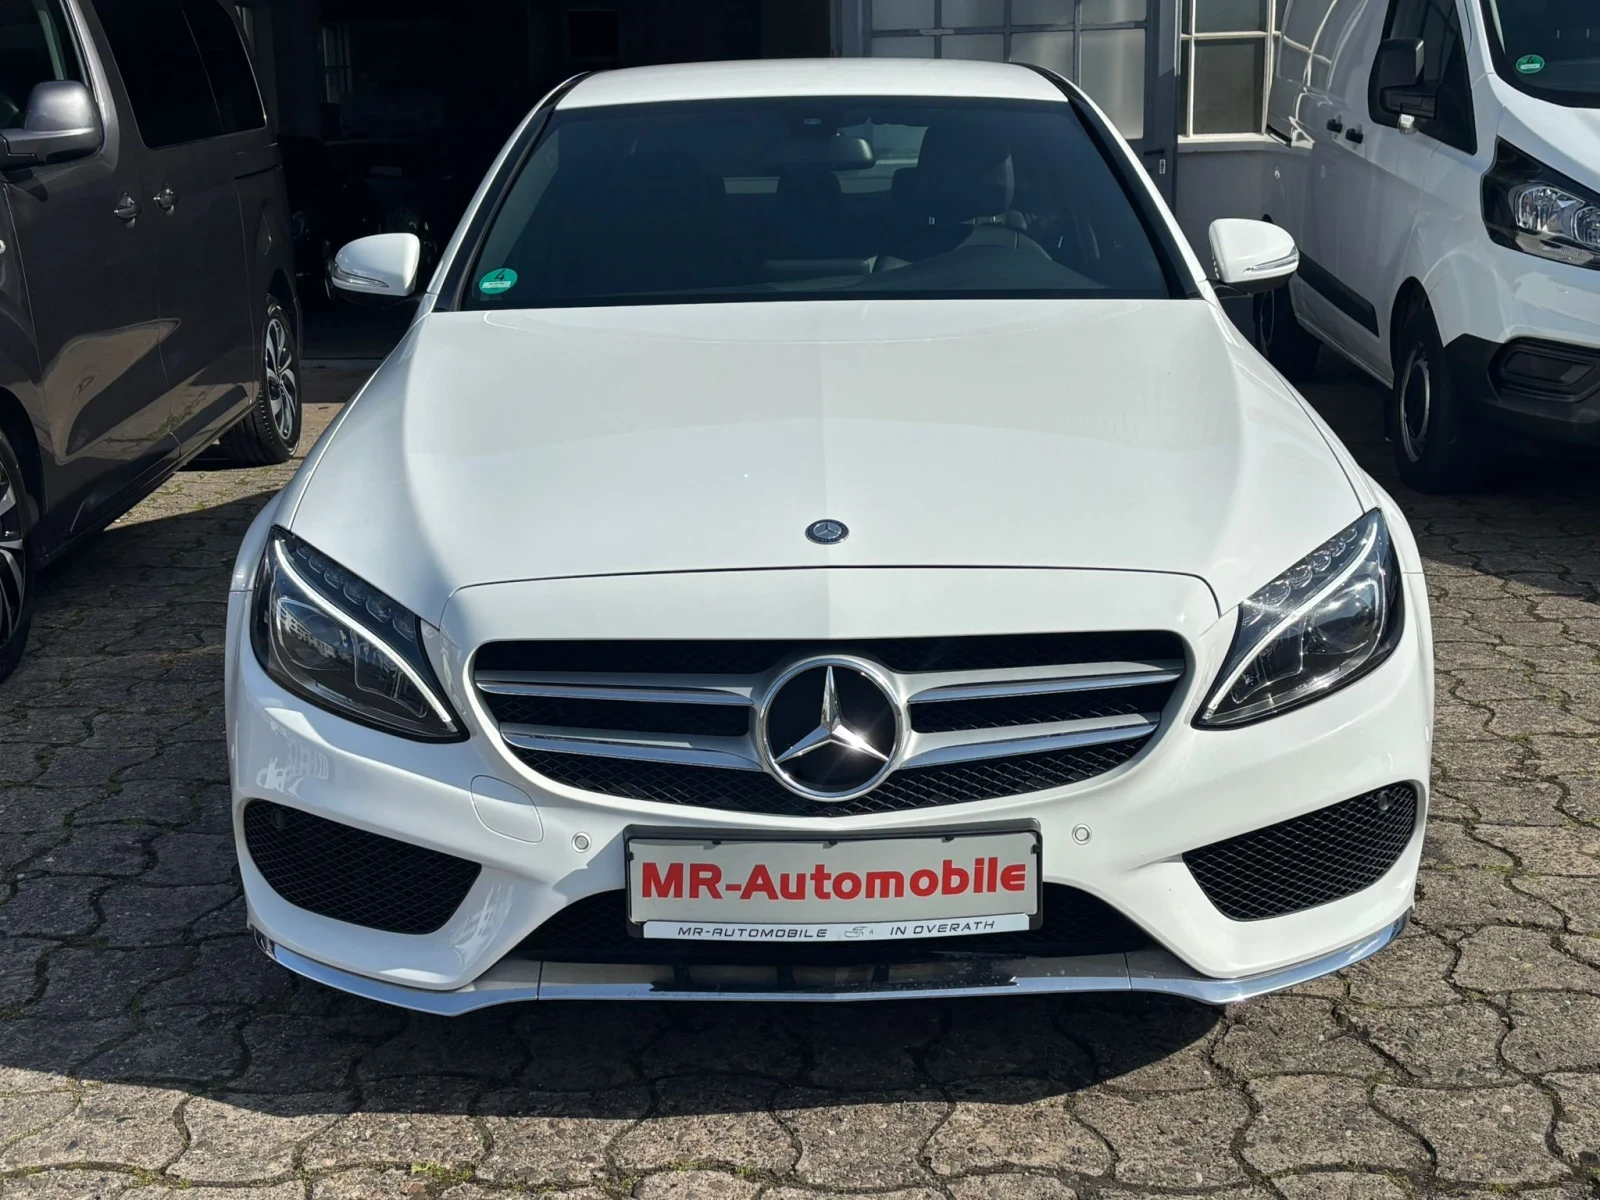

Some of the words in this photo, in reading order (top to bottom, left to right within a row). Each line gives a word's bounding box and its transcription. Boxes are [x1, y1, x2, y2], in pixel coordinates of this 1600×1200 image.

[494, 269, 506, 281] 4
[641, 857, 1026, 900] MR-Automobile
[677, 926, 828, 938] MR-AUTOMOBILE
[890, 926, 906, 936] IN
[913, 920, 995, 935] OVERATH
